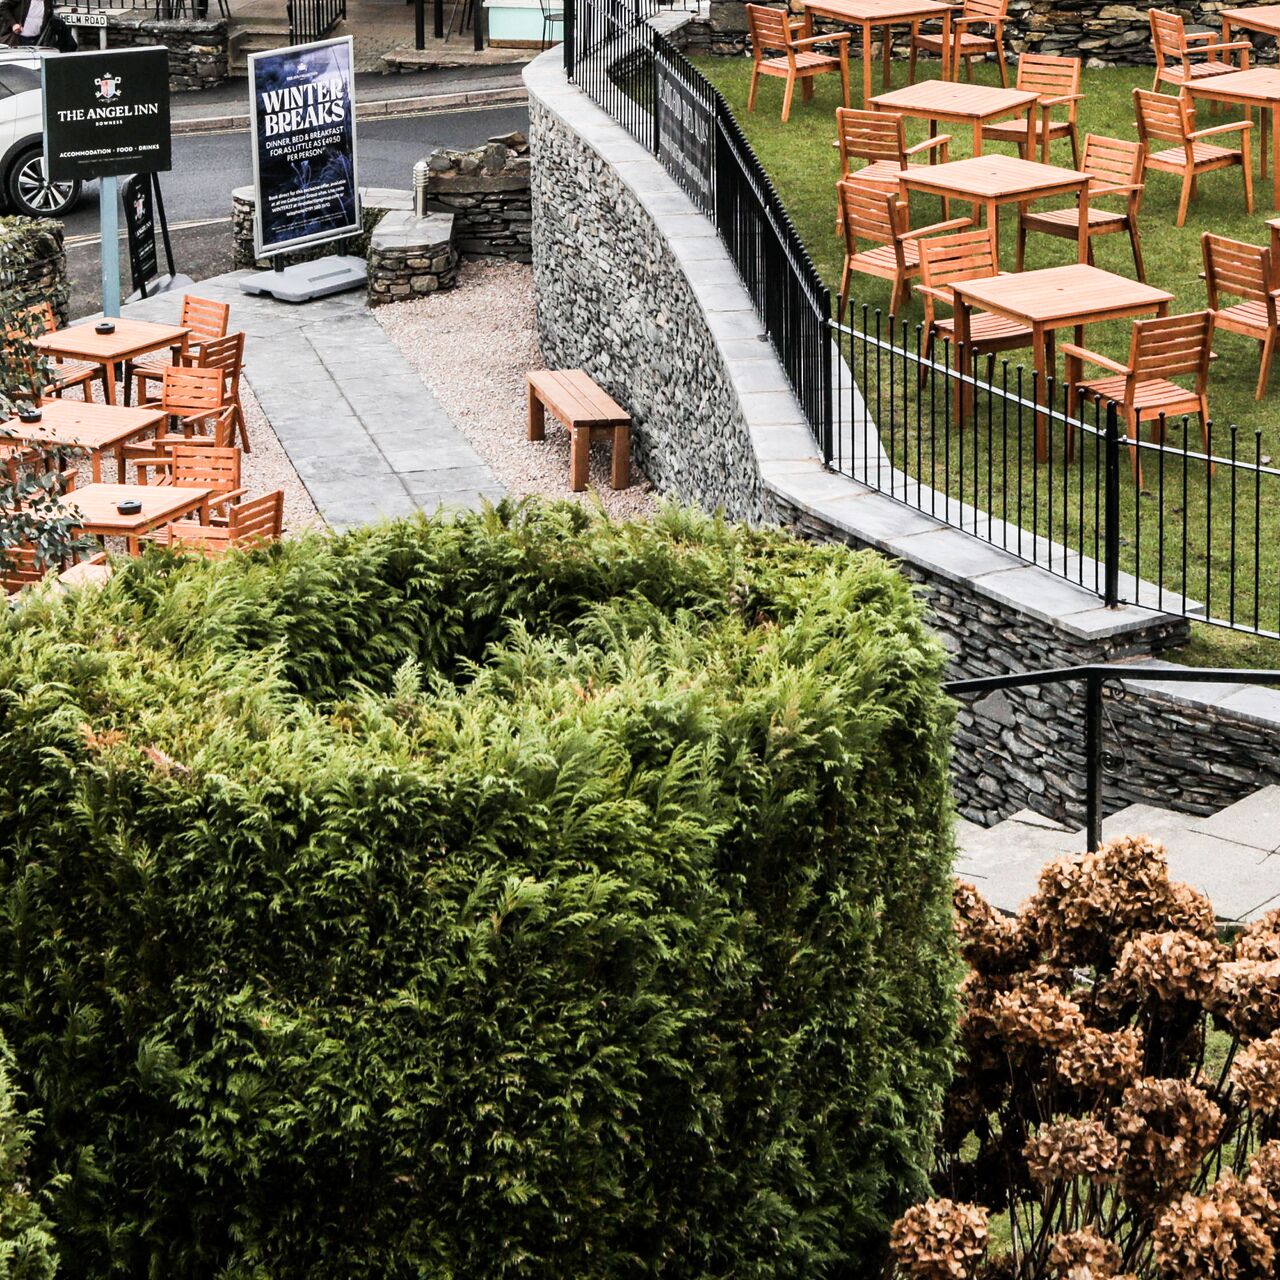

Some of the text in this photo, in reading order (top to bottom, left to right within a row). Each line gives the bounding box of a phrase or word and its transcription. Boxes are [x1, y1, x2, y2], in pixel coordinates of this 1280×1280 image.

[84, 16, 106, 25] ROAD
[262, 80, 344, 113] WINTER
[57, 103, 158, 121] THE ANGEL INN
[264, 100, 345, 136] BREAKS
[266, 139, 291, 149] DINNER,
[292, 135, 304, 143] BED
[310, 126, 344, 139] BREAKFAST
[270, 148, 283, 157] FOR
[292, 141, 312, 152] LITTLE
[322, 135, 340, 146] £49.50
[59, 148, 111, 158] ACCOMMODATION
[138, 143, 160, 151] DRINKS
[287, 153, 298, 161] PER
